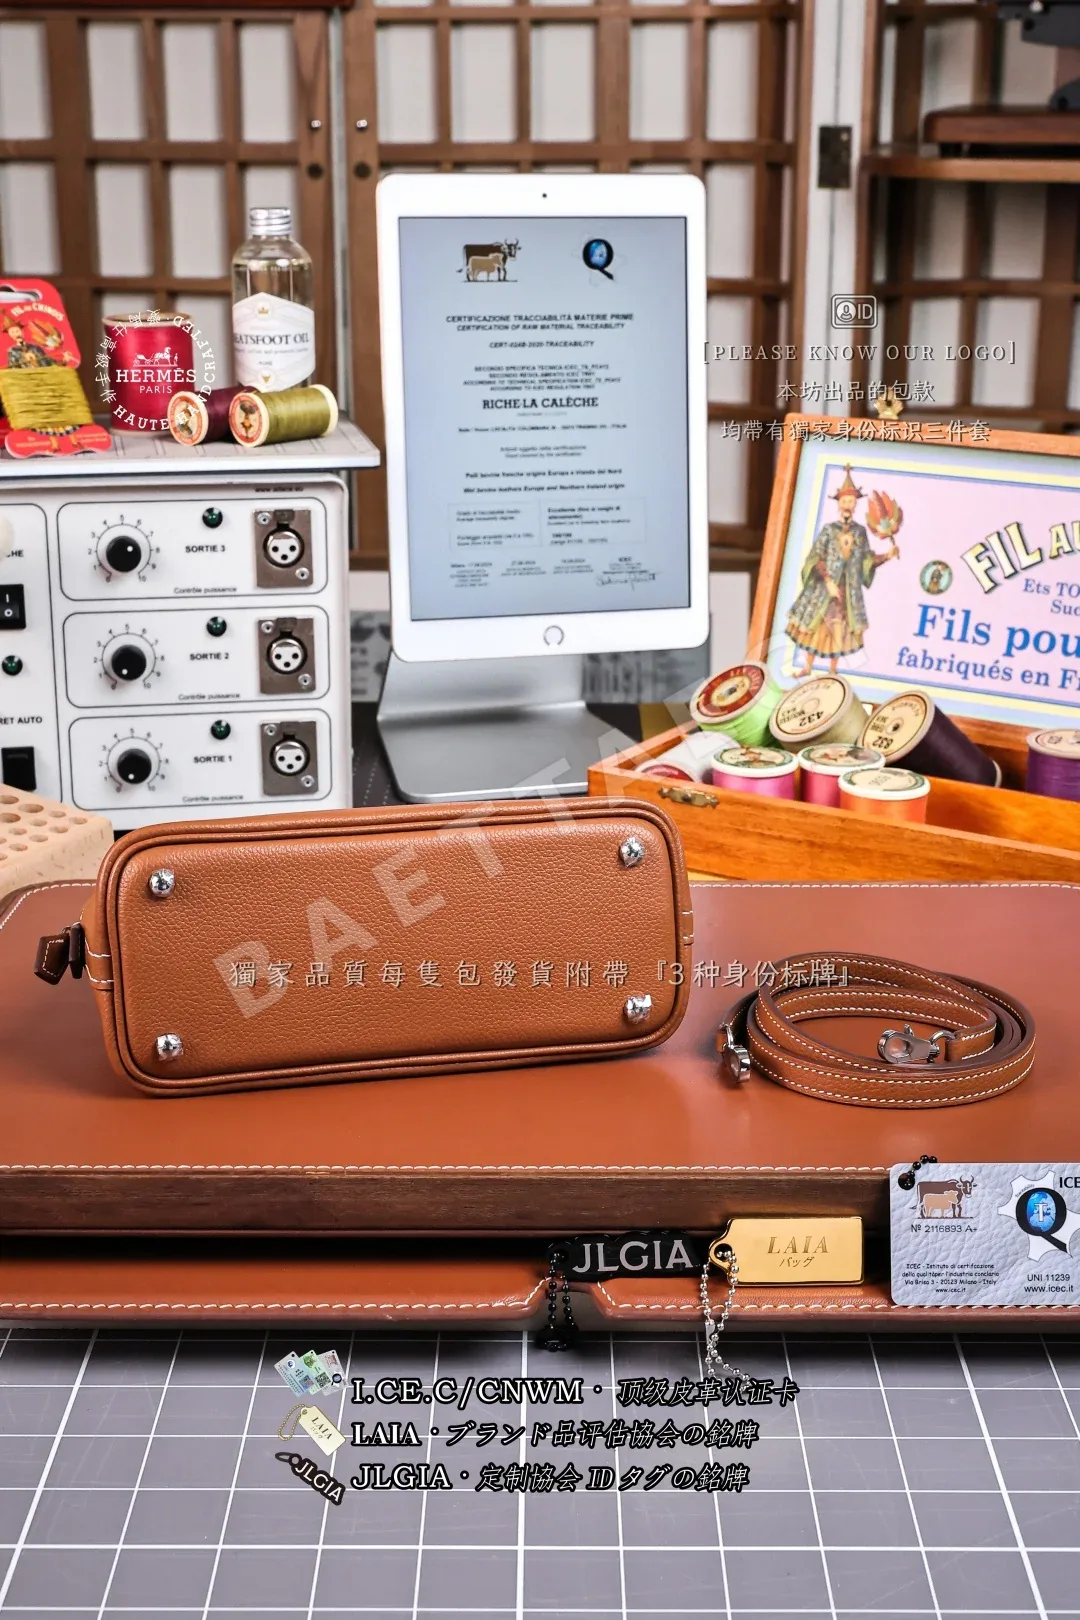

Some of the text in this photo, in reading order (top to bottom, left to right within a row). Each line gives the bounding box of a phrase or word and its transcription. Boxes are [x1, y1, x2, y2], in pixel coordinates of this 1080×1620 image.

[6, 550, 24, 558] HE
[185, 544, 226, 554] SORTIE 3
[961, 522, 1044, 594] FIL
[1023, 578, 1050, 596] Ets
[913, 603, 992, 647] Fils
[190, 651, 230, 660] SORTIE 2
[897, 646, 1080, 691] fabriqués en F
[18, 716, 43, 725] AUTO
[194, 755, 233, 764] SORTIE 1
[924, 1224, 963, 1233] 2116893
[766, 1235, 831, 1256] LAIA
[573, 1238, 697, 1274] JLGIA
[779, 1255, 815, 1269] バッグ
[1027, 1274, 1071, 1282] UNI 11239
[1024, 1285, 1074, 1293] www.icec.it
